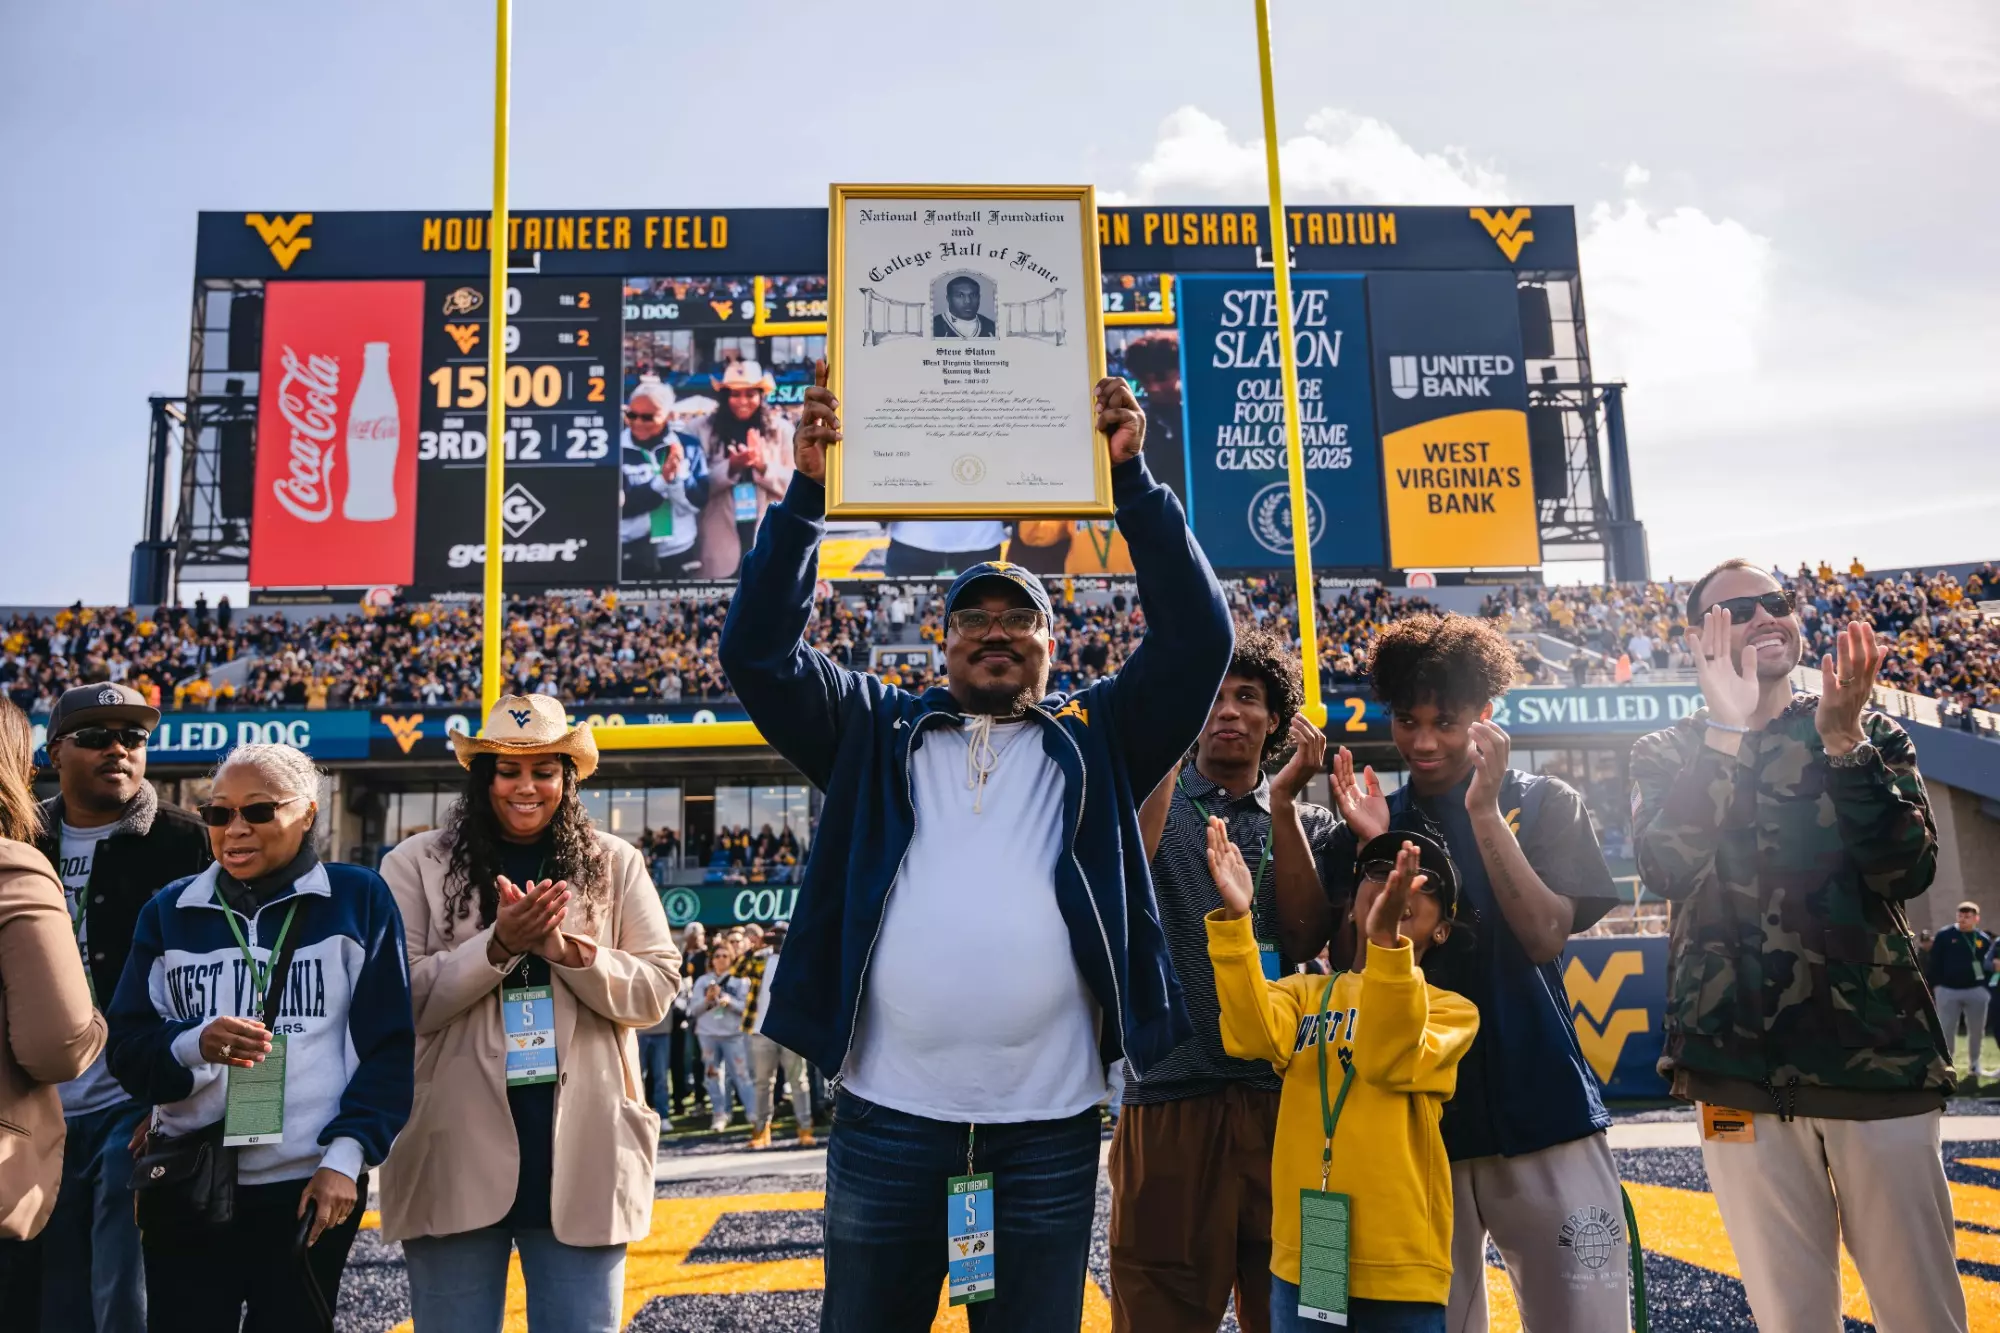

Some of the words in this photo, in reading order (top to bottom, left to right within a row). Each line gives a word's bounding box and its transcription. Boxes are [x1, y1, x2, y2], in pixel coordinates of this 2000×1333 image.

[859, 209, 917, 225] National
[923, 209, 981, 225] Football
[988, 209, 1065, 225] Foundation
[1143, 212, 1258, 246] PUSKAR
[1289, 212, 1397, 246] TADIUM
[422, 217, 631, 251] MOUTAINEER
[644, 216, 727, 249] FIELD
[951, 227, 974, 236] and
[868, 249, 933, 283] College
[939, 242, 982, 261] Hall
[989, 248, 1009, 260] of
[1009, 251, 1059, 283] Fame
[577, 292, 591, 309] 2
[642, 303, 679, 319] DOG
[1220, 289, 1329, 327] STEVE
[576, 329, 590, 347] 2
[936, 347, 961, 356] Steve
[965, 347, 996, 356] Slaton
[1420, 354, 1515, 376] UNITED
[428, 364, 562, 409] 1500
[587, 377, 606, 402] 2
[1236, 378, 1323, 401] COLLGE
[1422, 376, 1491, 397] BANK
[1233, 402, 1328, 424] FOOTALL
[418, 430, 487, 460] 3RD
[503, 429, 542, 460] 12
[565, 428, 609, 459] 23
[1216, 425, 1265, 447] HALL
[1300, 424, 1349, 446] FAME
[1216, 448, 1276, 470] CLASS
[1306, 447, 1353, 469] 2025
[1423, 442, 1490, 463] WEST
[1396, 466, 1521, 489] VIRGINIA'S
[1427, 492, 1496, 514] BANK
[1345, 698, 1367, 732] 2
[1519, 695, 1659, 724] SWILLED
[1668, 693, 1708, 719] DO
[236, 720, 311, 749] DOG
[733, 888, 800, 921] COLL
[167, 961, 223, 1022] WEST
[522, 1001, 534, 1026] S
[273, 1023, 304, 1036] ERS
[953, 1182, 967, 1194] WEST
[967, 1179, 989, 1192] VIRGINIA
[965, 1193, 976, 1226] S
[1558, 1205, 1622, 1247] WORLDWIDE
